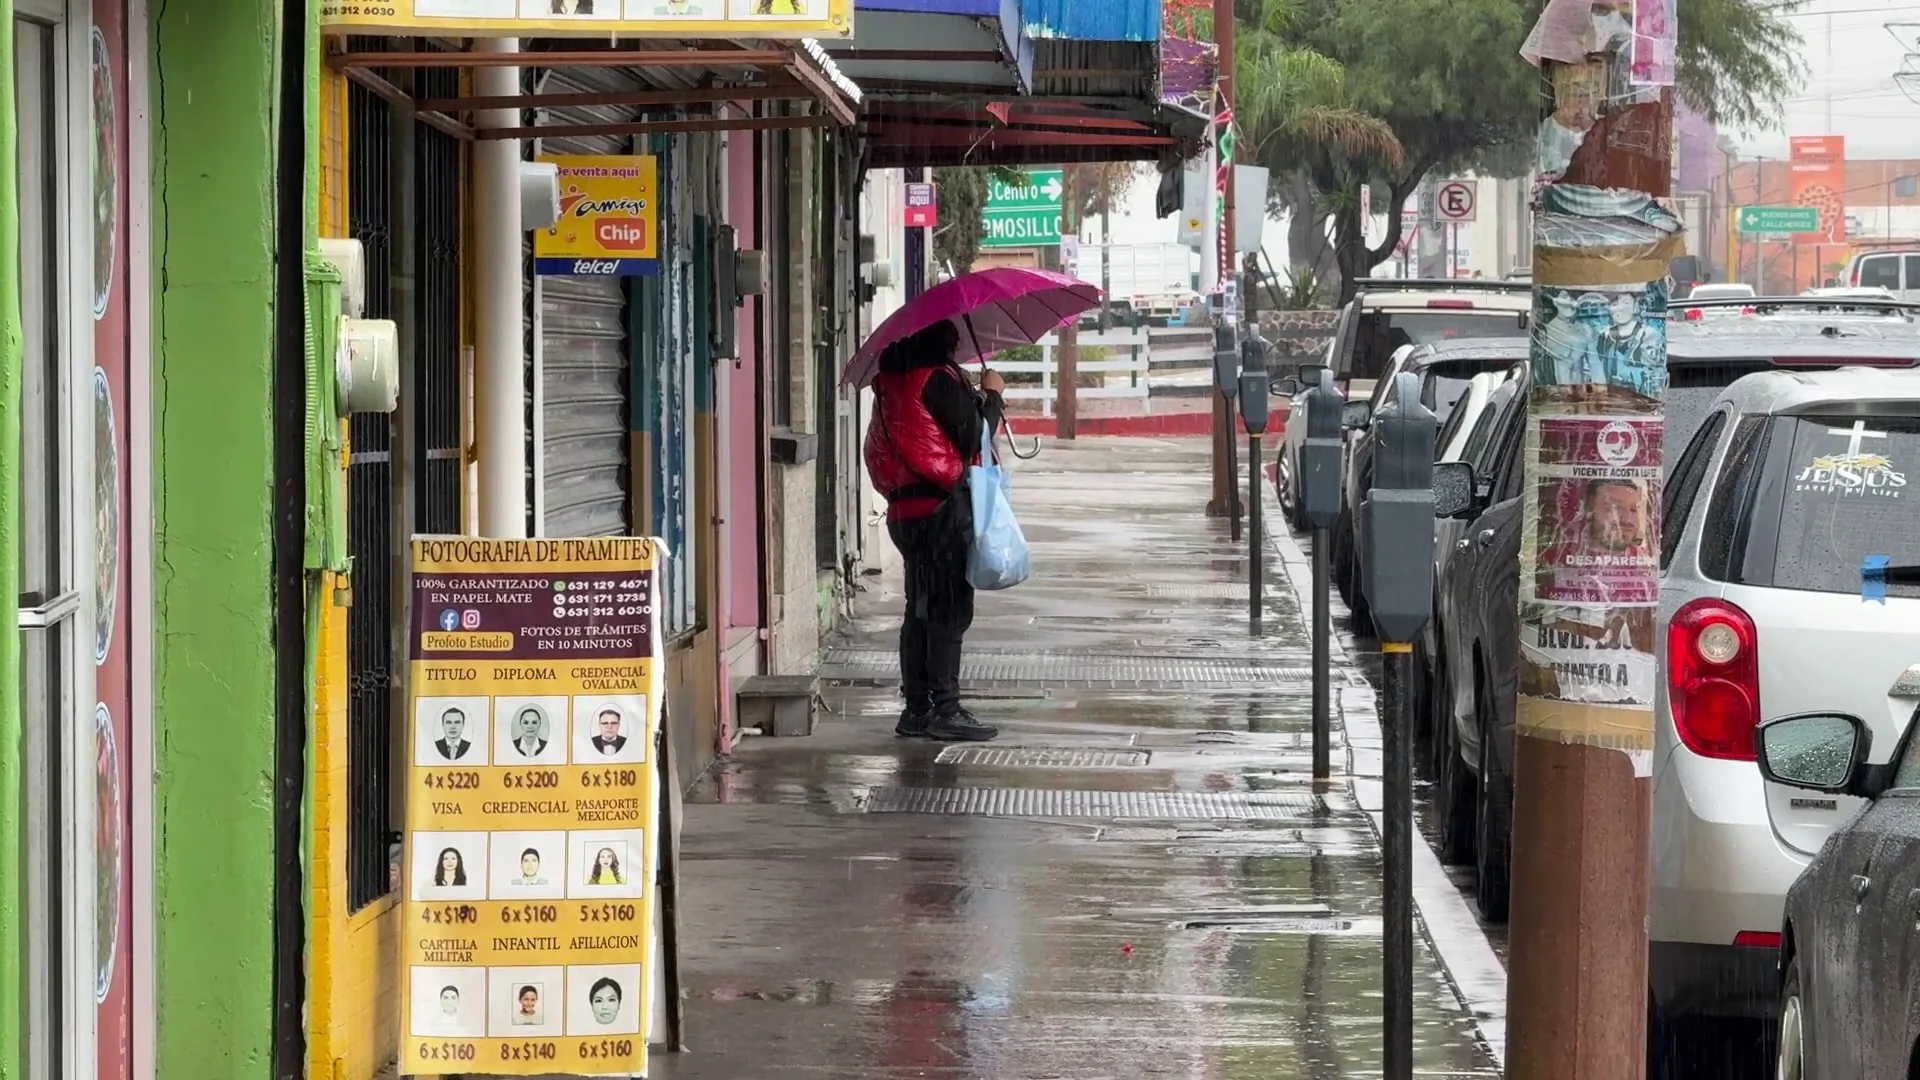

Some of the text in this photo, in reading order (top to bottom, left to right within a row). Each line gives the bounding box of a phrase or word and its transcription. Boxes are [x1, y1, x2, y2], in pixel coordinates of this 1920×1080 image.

[341, 6, 359, 15] 312
[364, 7, 395, 16] 6030
[572, 167, 609, 176] venta
[612, 166, 638, 178] aquí
[994, 181, 1038, 200] Centro
[600, 225, 640, 244] Chip
[573, 259, 620, 274] telcel
[1572, 467, 1609, 477] VICENTE
[1610, 467, 1640, 477] ACOSTA
[1795, 465, 1907, 488] JESUS
[1872, 489, 1900, 498] LIFE
[535, 541, 559, 562] DE
[563, 538, 650, 561] TRAMITES
[415, 579, 549, 589] 100% GARANTIZADO
[568, 580, 648, 590] 631 129 4671
[431, 593, 533, 603] EN PAPEL MATE
[568, 593, 646, 603] 631 171 3738
[567, 606, 651, 617] 631 312 6030
[521, 623, 646, 637] FOTOS DE TRÁMITES
[427, 635, 509, 649] Profoto Estudio
[537, 639, 632, 650] EN 10 MINUTOS
[425, 668, 477, 680] TITULO
[493, 668, 556, 680] DIPLOMA
[571, 667, 646, 678] CREDENCIAL
[582, 679, 637, 689] OVALADA
[424, 772, 479, 790] 4 x $220
[503, 771, 558, 788] 6 x $200
[582, 770, 636, 787] 6 x $180
[432, 803, 462, 814] VISA
[482, 802, 569, 814] CREDENCIAL
[575, 798, 638, 809] PASAPORTE
[577, 810, 639, 821] MEXICANO
[422, 908, 431, 922] 4
[501, 905, 556, 923] 6 x $160
[580, 904, 634, 922] 5 x $160
[419, 939, 477, 950] CARTILLA
[492, 937, 560, 950] INFANTIL
[569, 935, 638, 949] AFILIACION
[424, 952, 473, 962] MILITAR
[420, 1043, 474, 1061] 6 x $160
[501, 1043, 555, 1060] 8 x $140
[579, 1040, 632, 1058] 6 x $160
